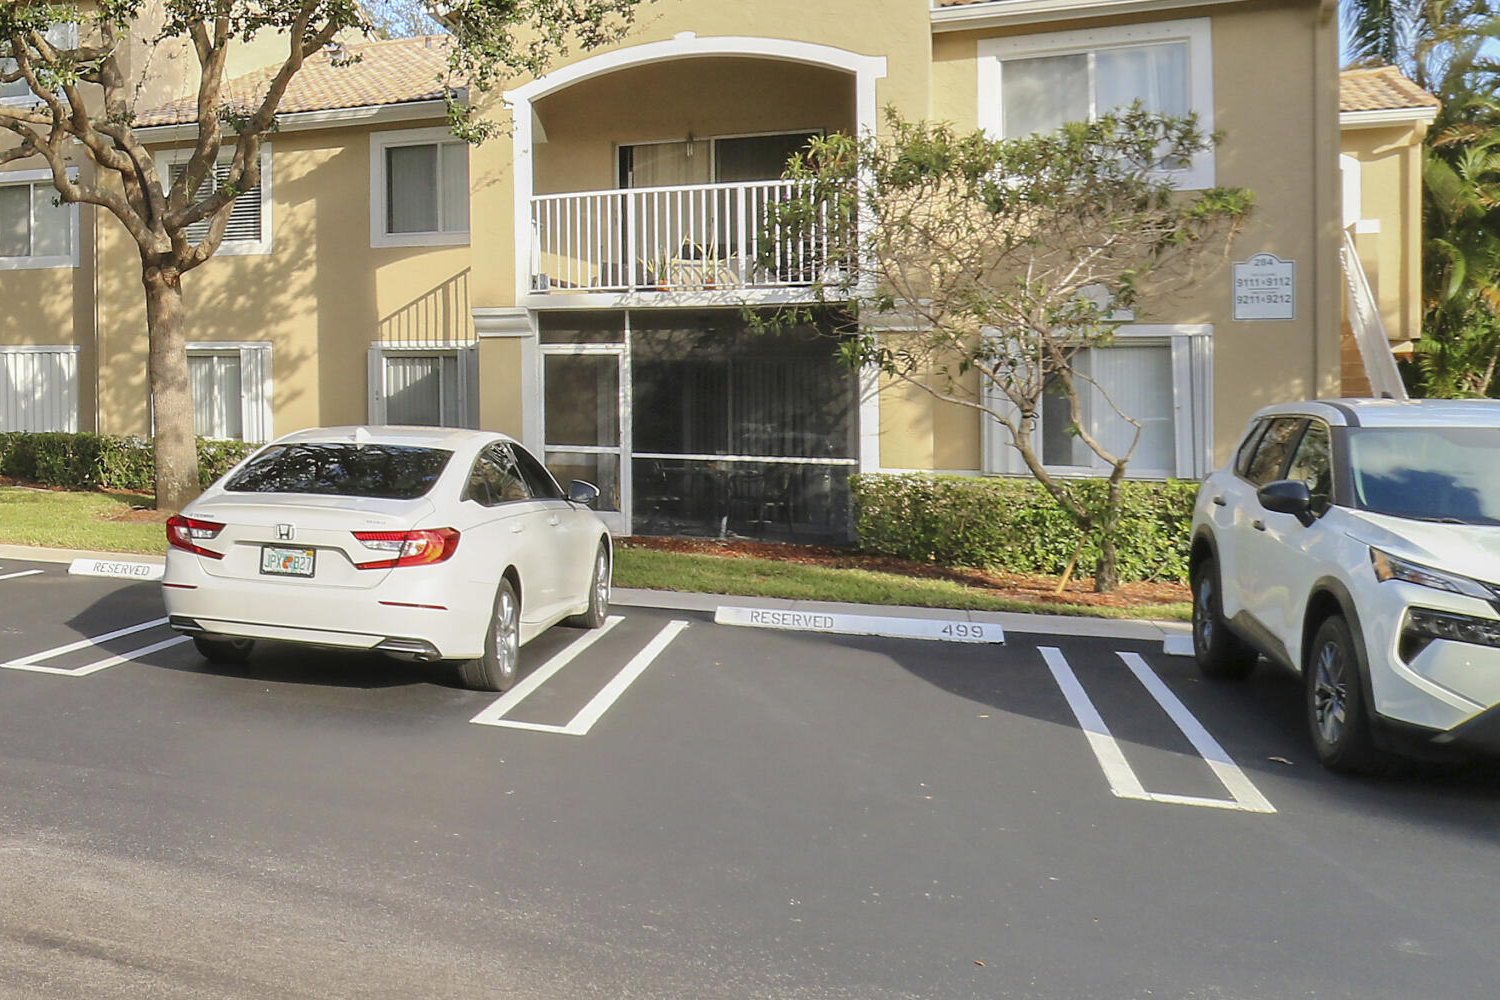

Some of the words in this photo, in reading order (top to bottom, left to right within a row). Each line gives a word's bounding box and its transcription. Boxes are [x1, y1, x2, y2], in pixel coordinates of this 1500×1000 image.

[1236, 278, 1260, 287] 9111
[1266, 277, 1291, 287] 9112
[1236, 295, 1260, 304] 9211
[1266, 294, 1291, 304] 9212
[93, 561, 151, 576] RESERVED
[749, 610, 835, 629] RESERVED
[940, 624, 984, 639] 499
